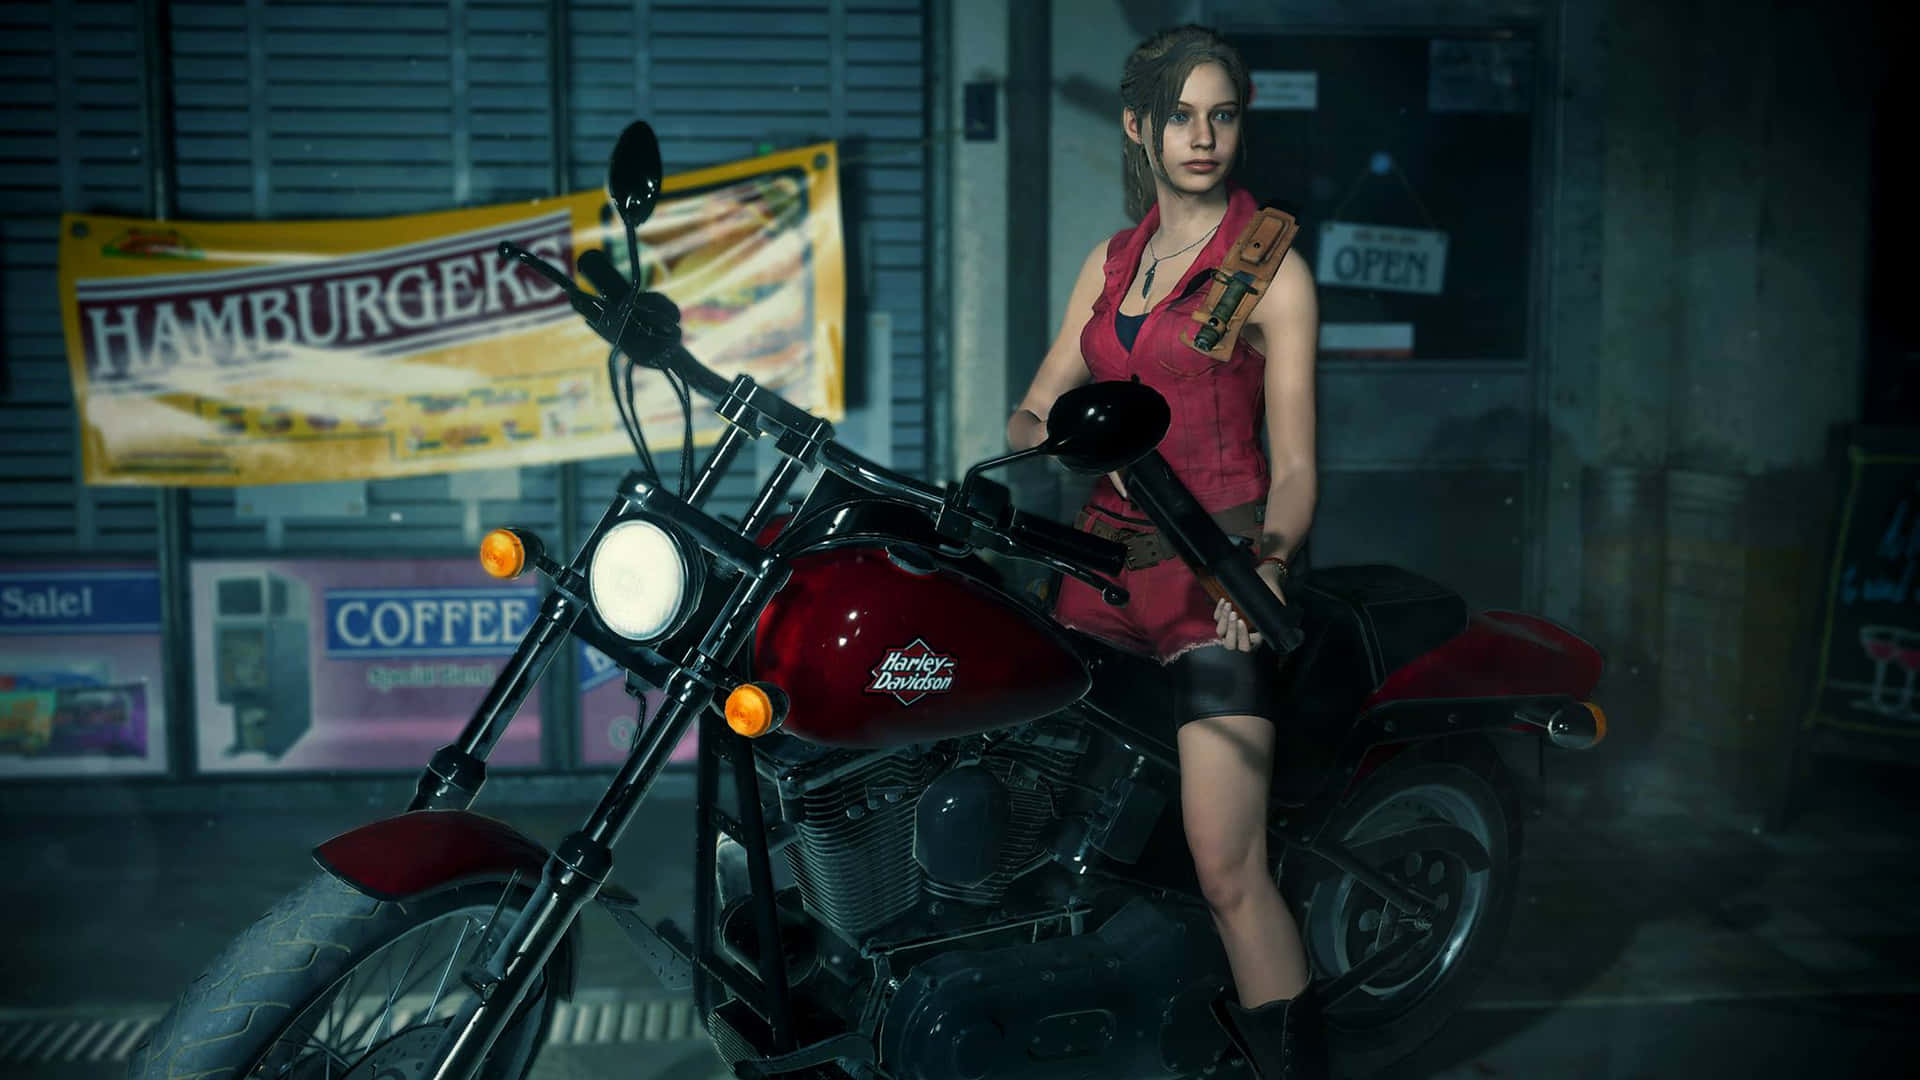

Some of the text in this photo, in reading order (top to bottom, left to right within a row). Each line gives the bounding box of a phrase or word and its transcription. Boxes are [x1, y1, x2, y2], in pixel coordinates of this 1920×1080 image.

[1333, 246, 1428, 286] OPEN
[88, 236, 568, 373] HAMBURGERS
[1, 586, 93, 617] Sale!
[336, 601, 528, 647] COFFEE
[872, 671, 953, 690] Davidson
[880, 651, 955, 675] Harley-
